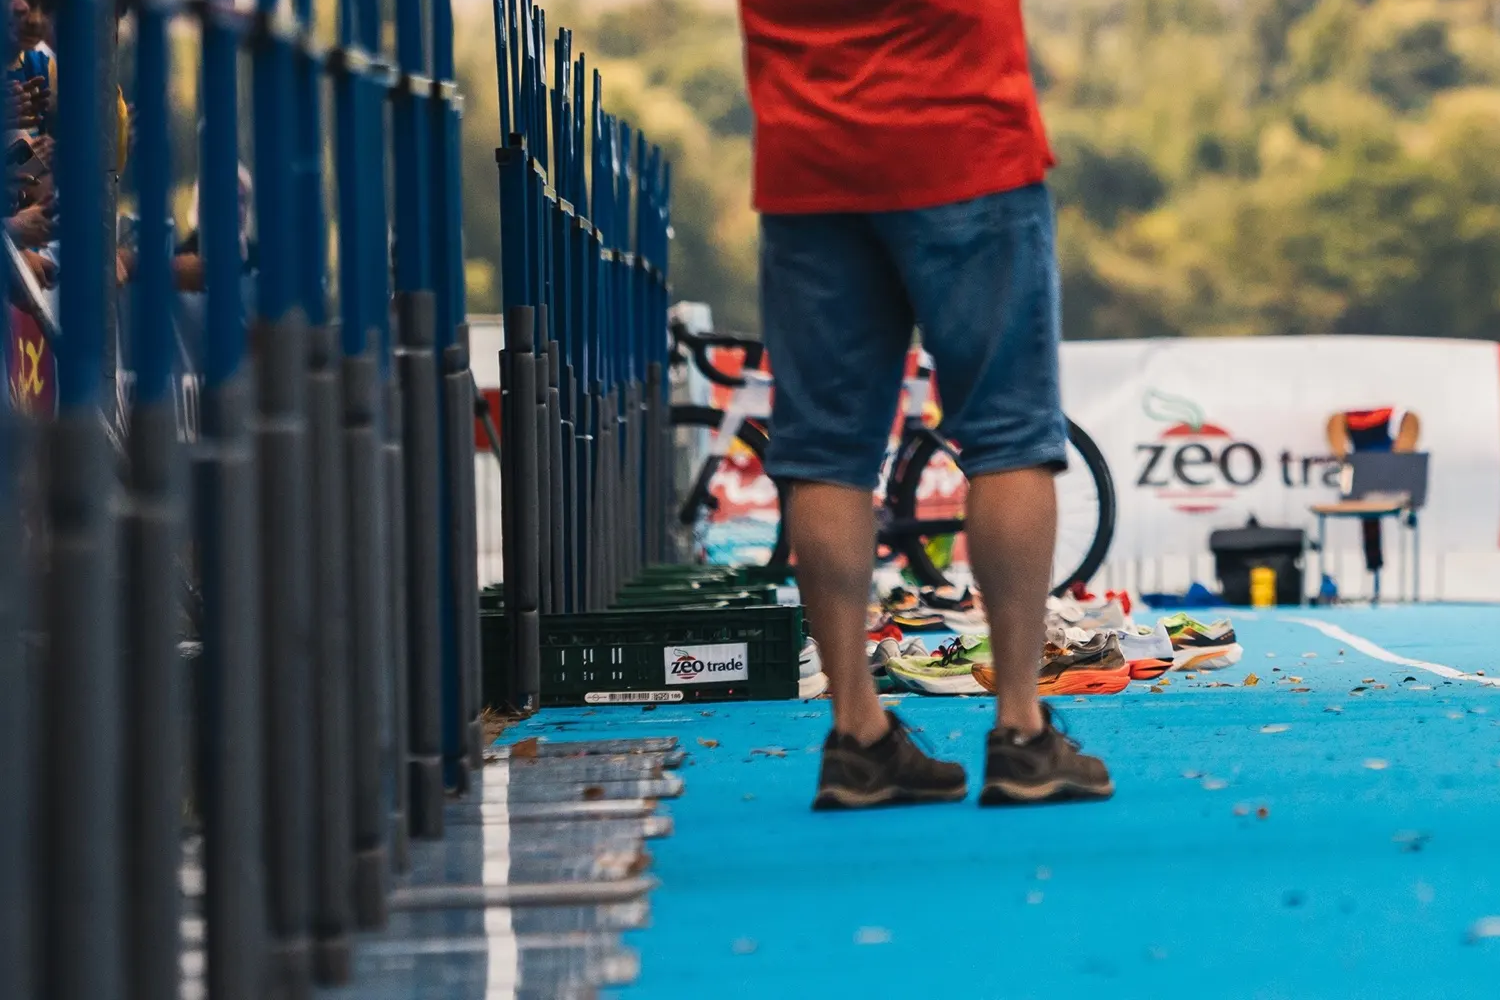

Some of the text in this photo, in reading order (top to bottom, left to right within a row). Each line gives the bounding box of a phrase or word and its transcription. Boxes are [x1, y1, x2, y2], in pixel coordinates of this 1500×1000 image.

[1134, 442, 1341, 488] zeo tra
[670, 658, 743, 674] zeo trade
